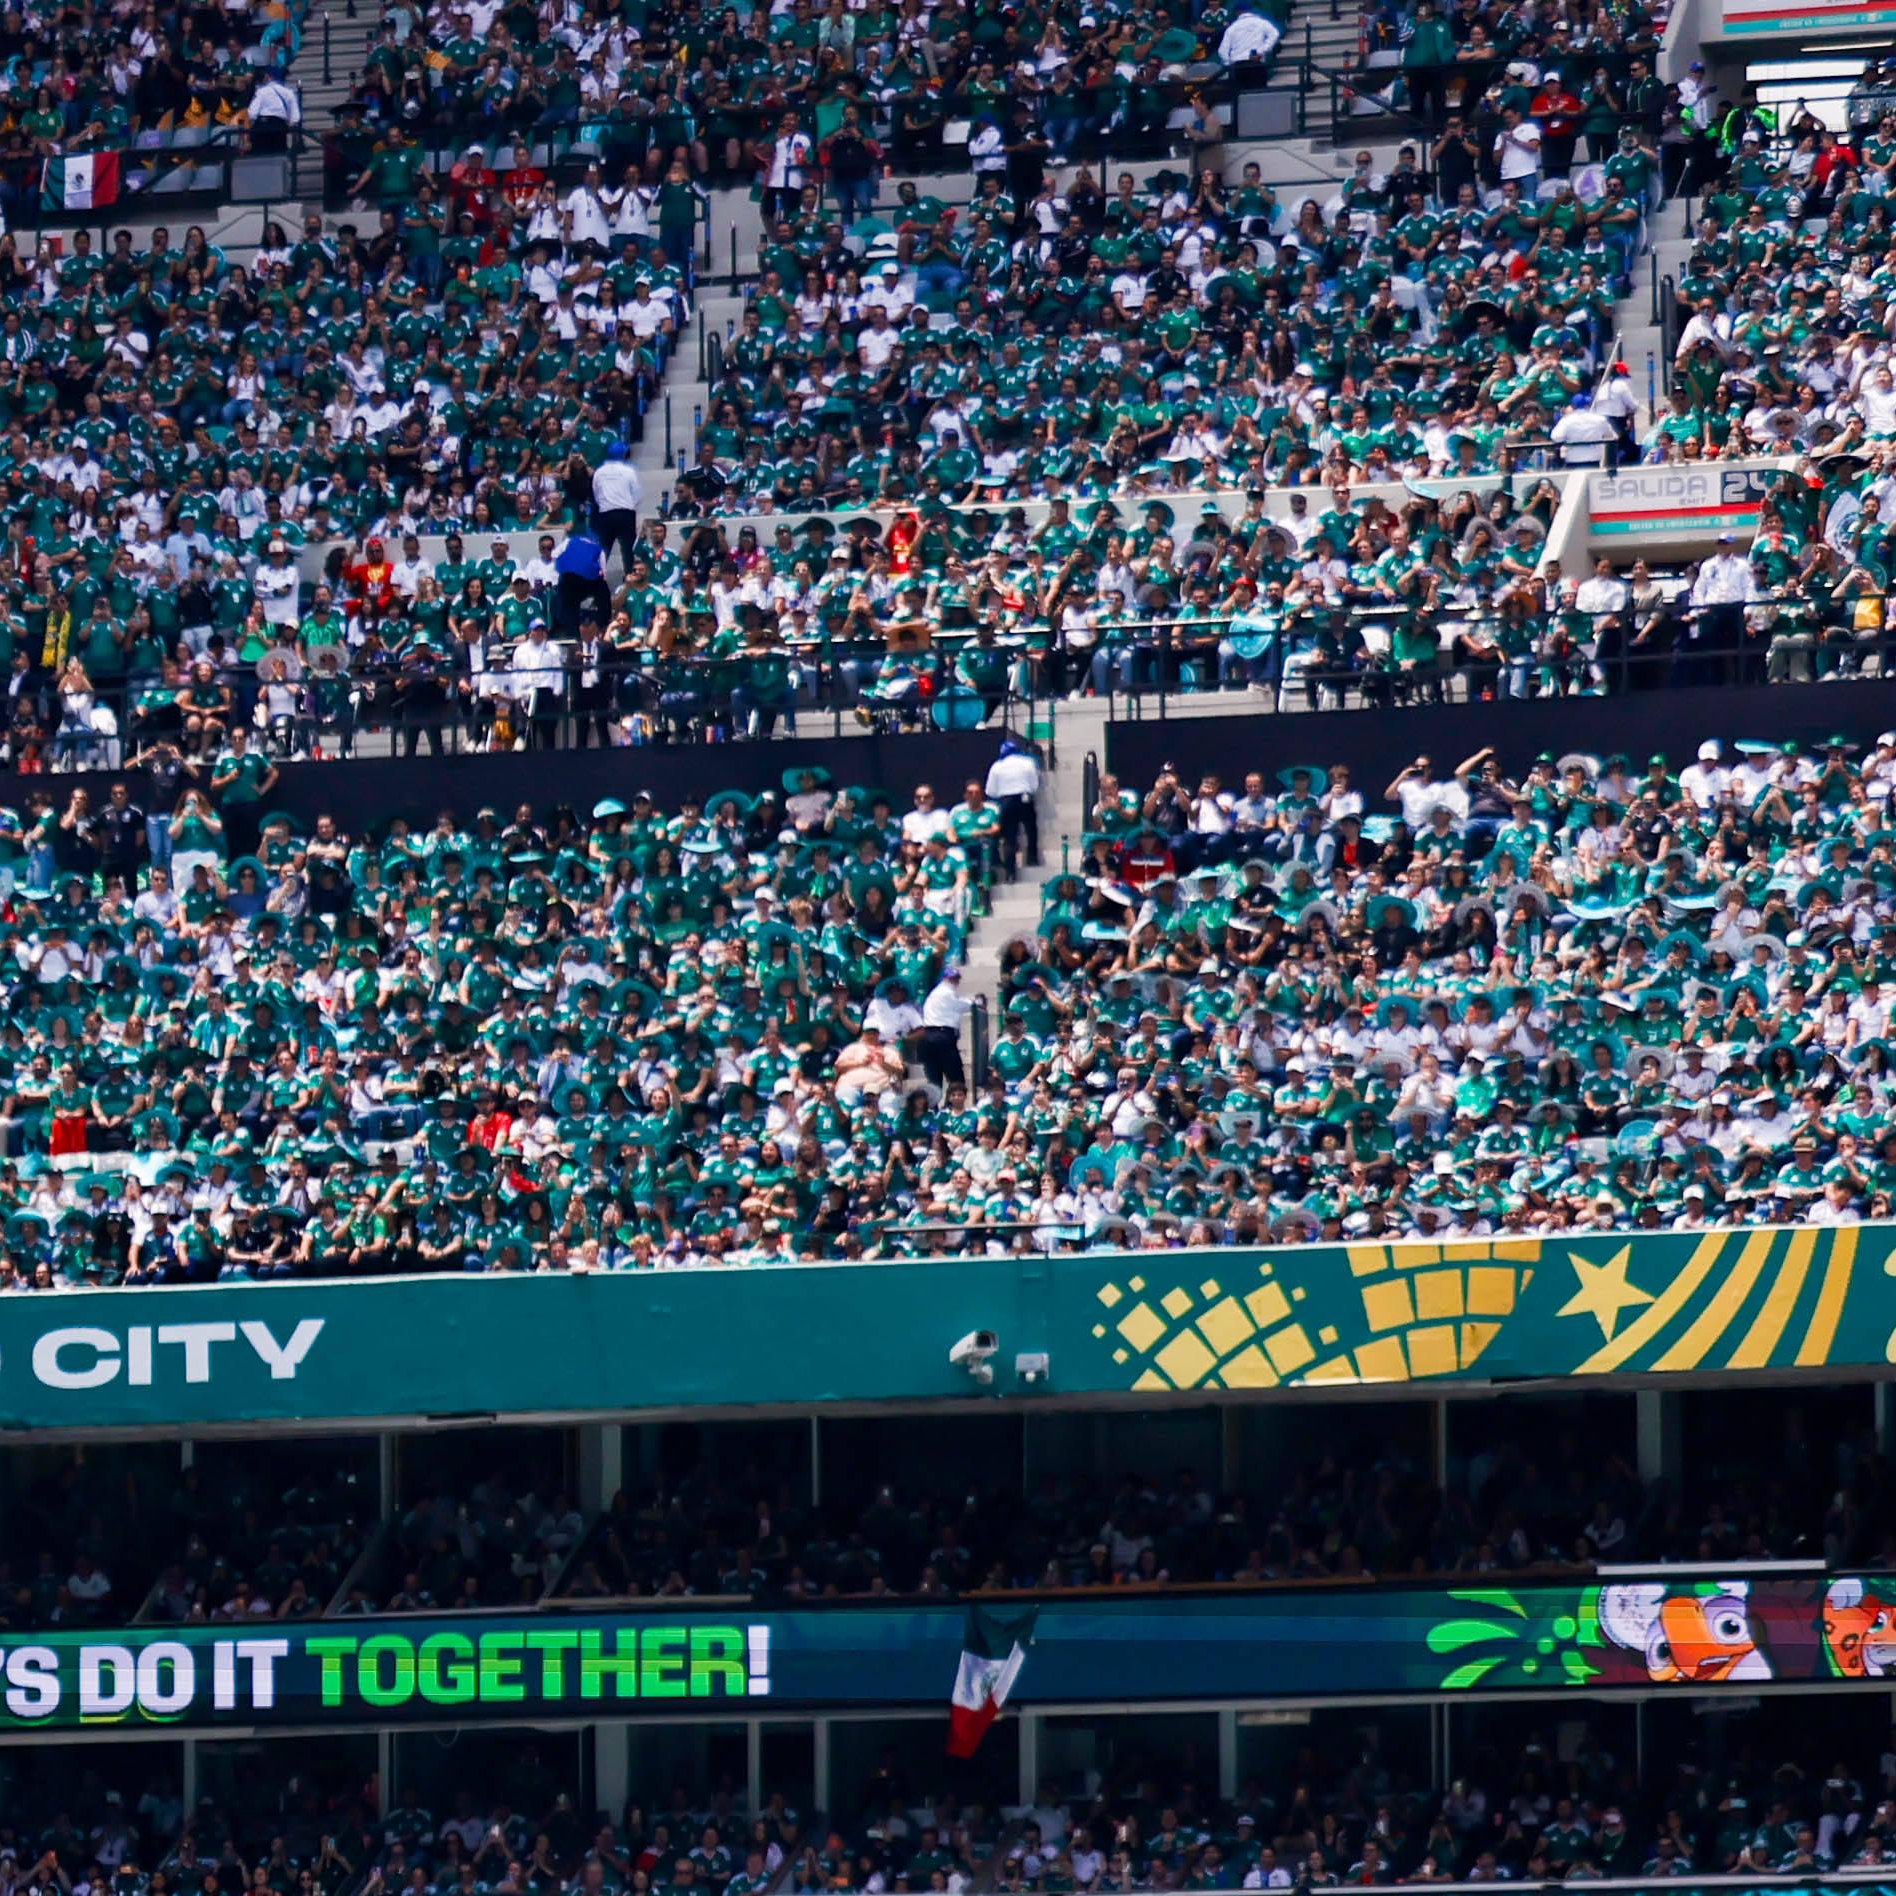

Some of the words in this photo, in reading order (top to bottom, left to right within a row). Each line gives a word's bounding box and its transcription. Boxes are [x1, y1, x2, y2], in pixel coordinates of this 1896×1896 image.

[1599, 475, 1707, 500] SALIDA
[32, 1319, 326, 1389] CITY
[79, 1641, 195, 1719] DO
[213, 1638, 289, 1710] IT
[304, 1624, 771, 1707] TOGETHER!
